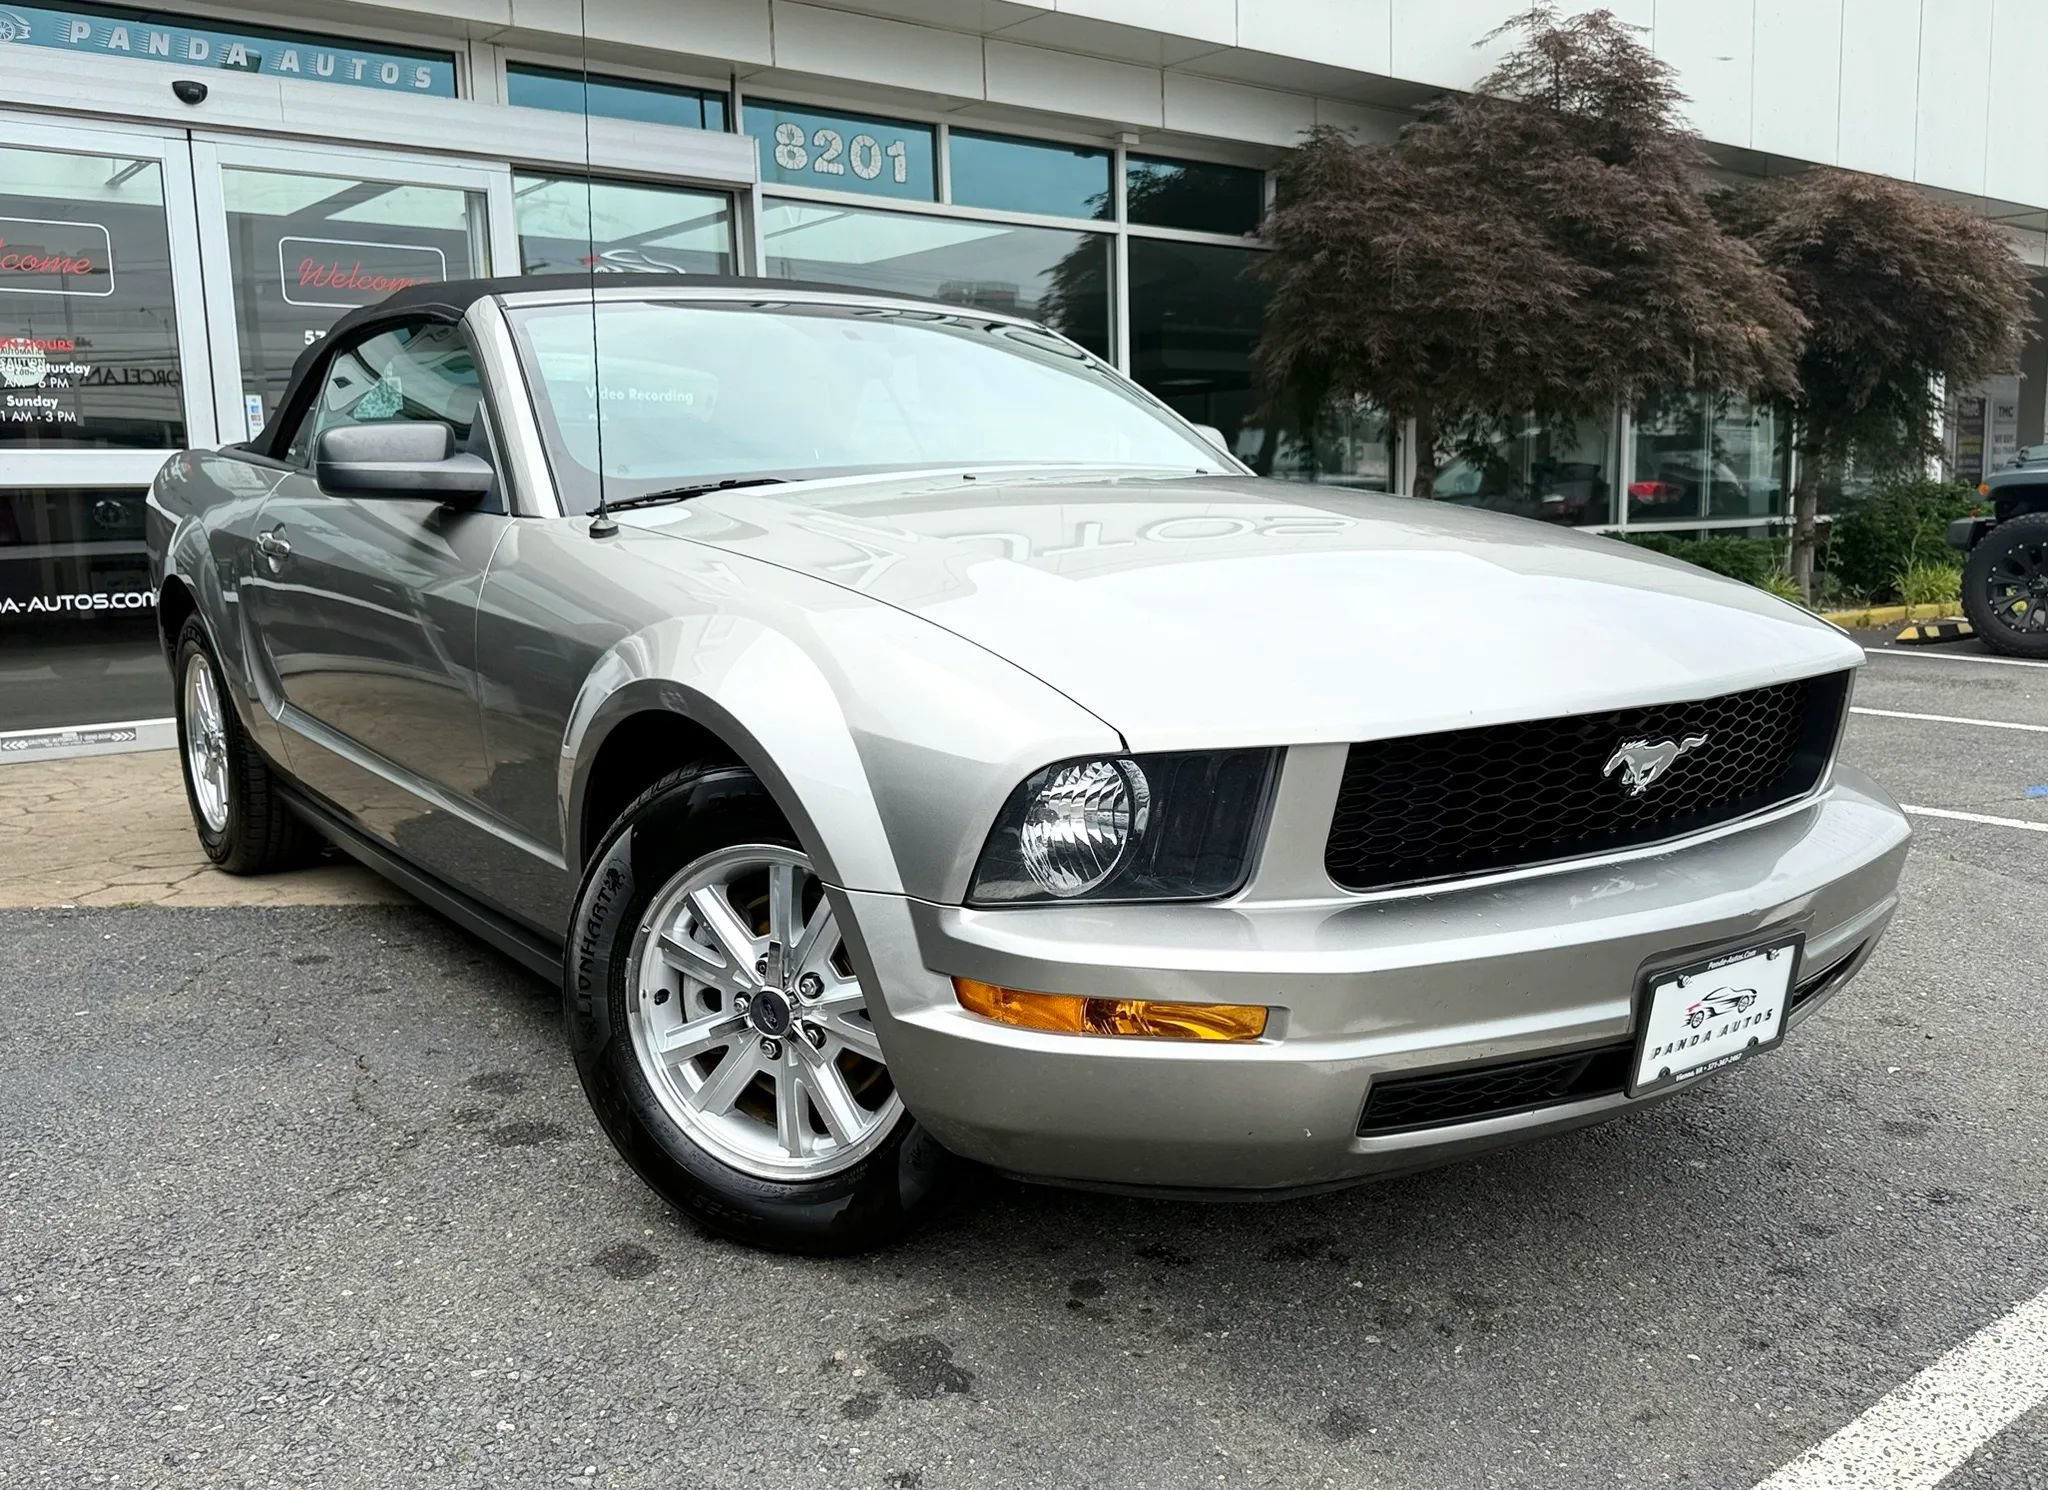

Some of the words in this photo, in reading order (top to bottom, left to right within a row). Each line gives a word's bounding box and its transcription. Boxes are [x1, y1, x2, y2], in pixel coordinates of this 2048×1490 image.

[68, 20, 248, 67] PANDA
[278, 49, 431, 89] AUTOS
[775, 122, 907, 184] 8201
[50, 377, 70, 389] PM
[6, 394, 59, 410] Sunday
[628, 388, 694, 406] Recording
[11, 410, 33, 422] AM
[45, 411, 54, 422] 3
[57, 411, 77, 422] PM
[1650, 1030, 1712, 1061] PANDA
[1718, 1008, 1773, 1038] AUTOS
